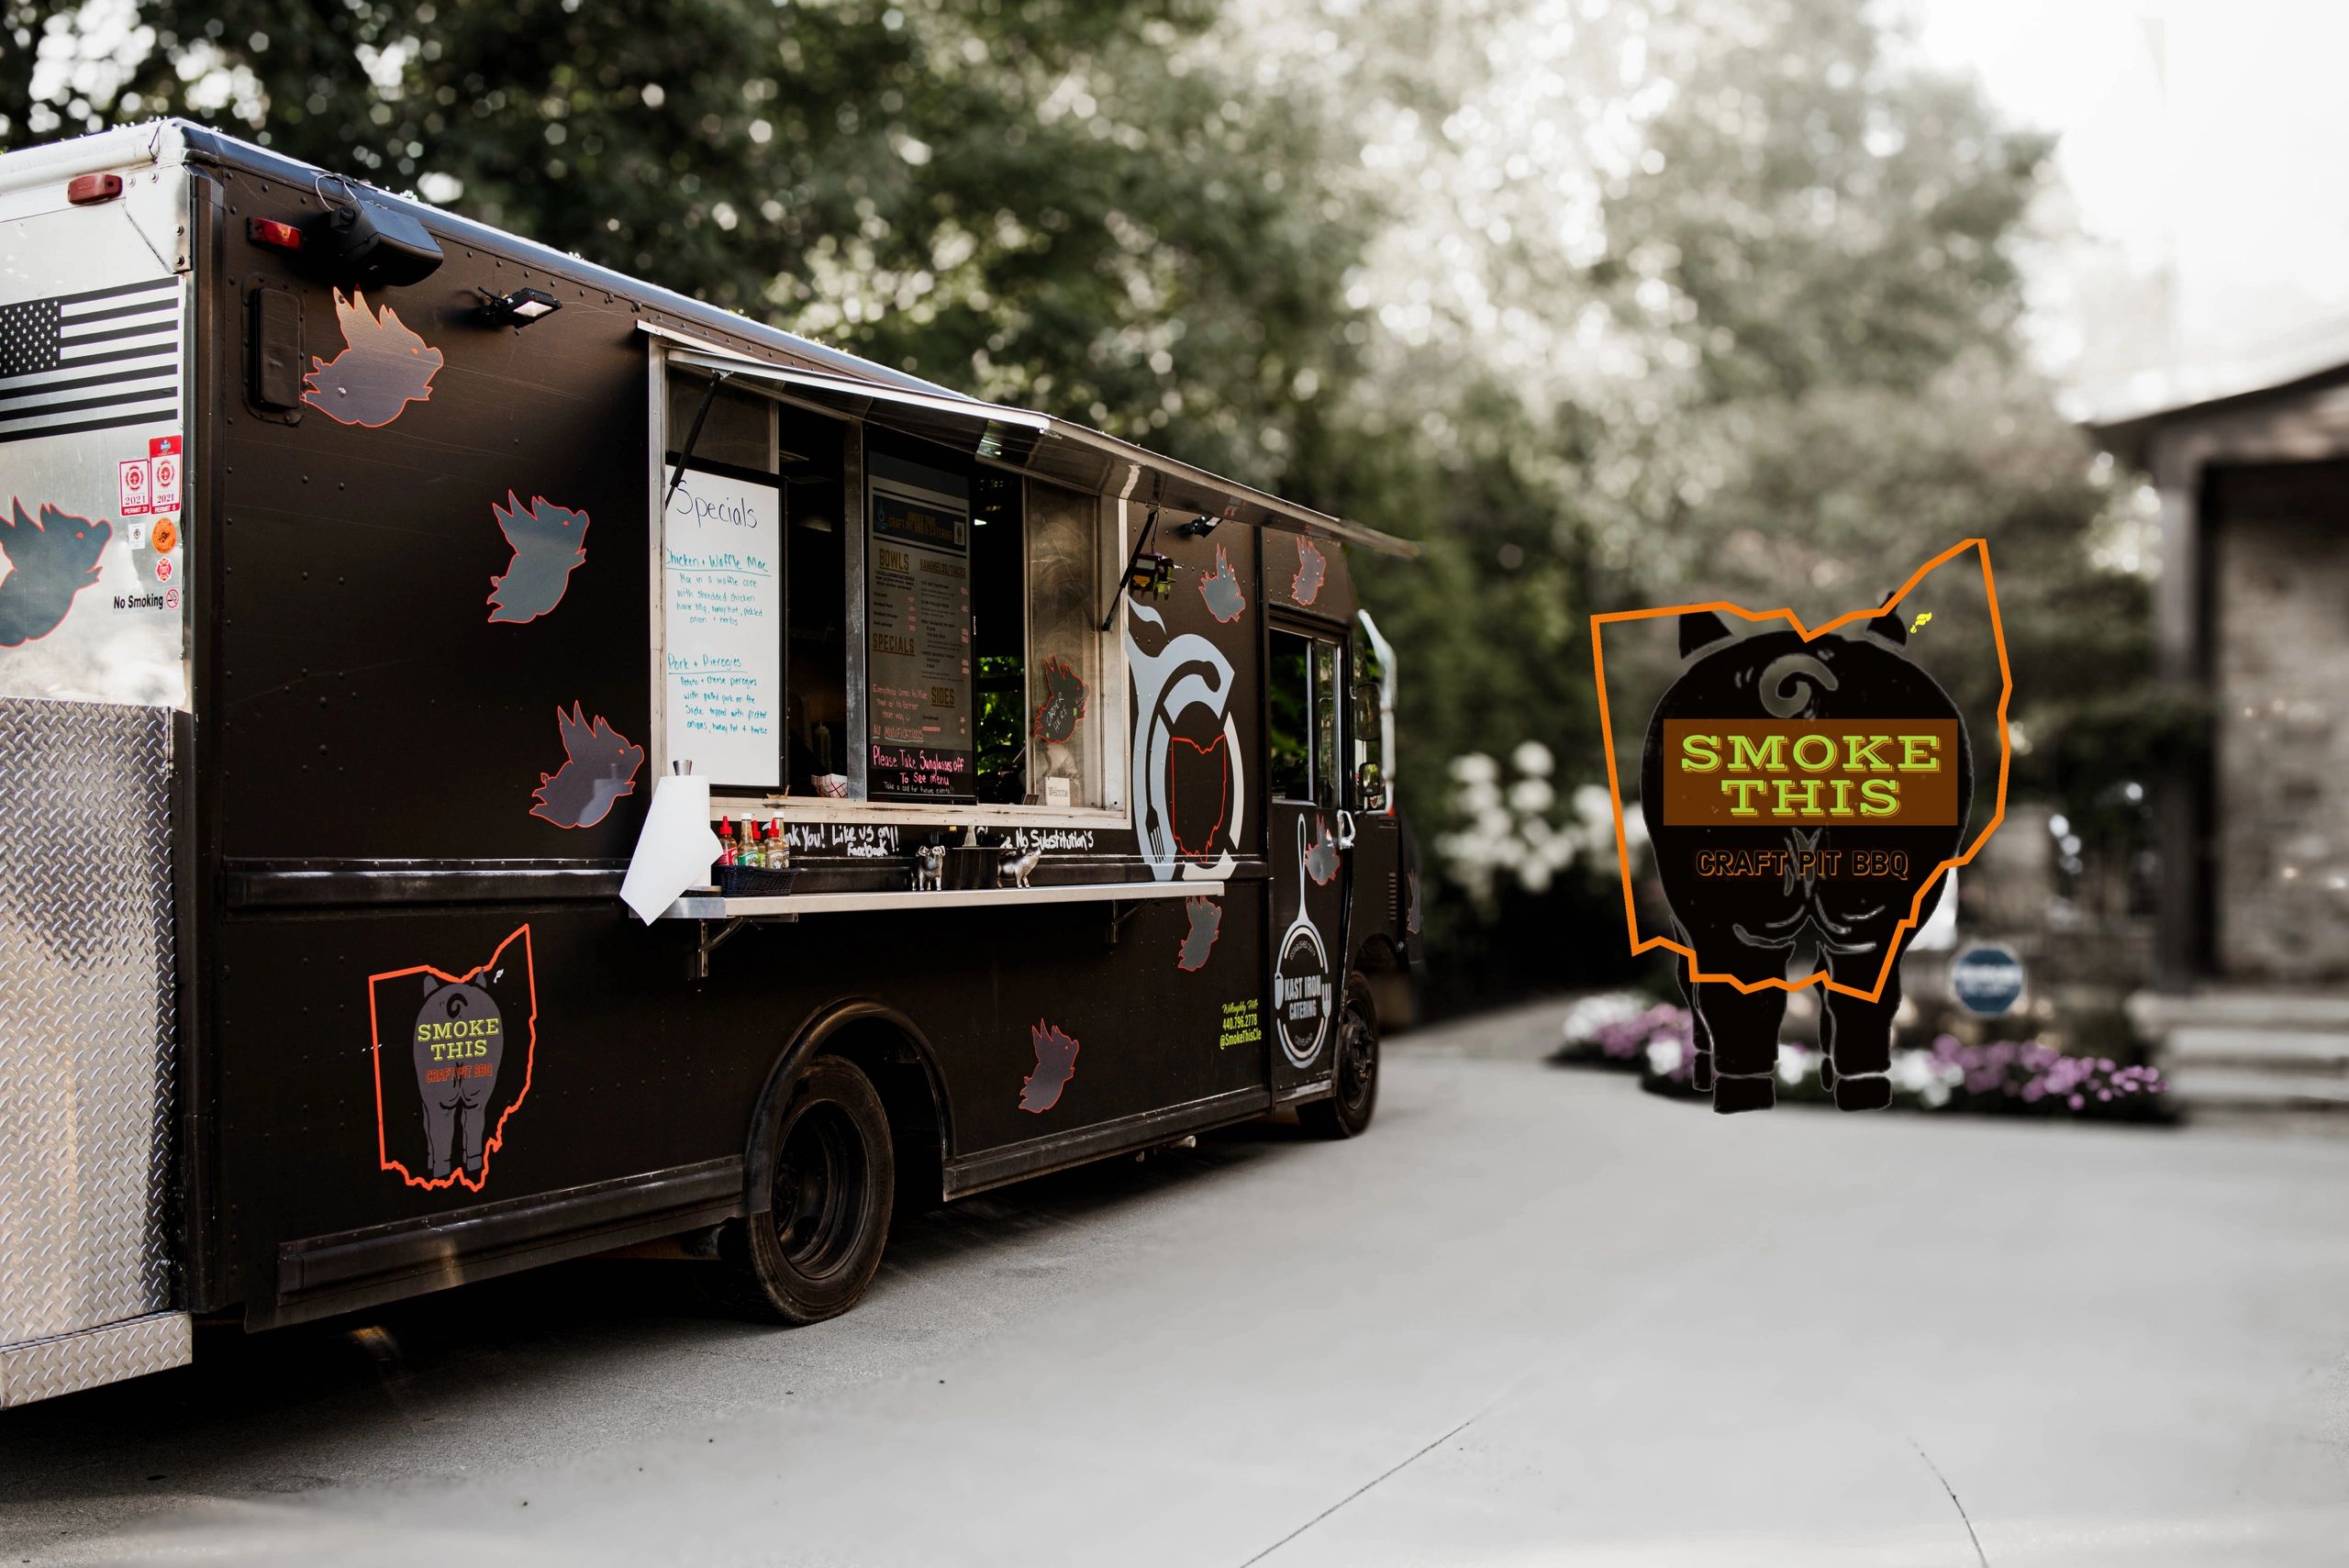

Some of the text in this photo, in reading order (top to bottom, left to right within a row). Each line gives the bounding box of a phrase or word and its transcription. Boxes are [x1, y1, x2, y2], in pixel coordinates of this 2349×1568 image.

[125, 495, 146, 506] 2021
[157, 494, 174, 504] 2021
[676, 479, 758, 528] Specials
[124, 506, 141, 515] PERMIT
[154, 506, 171, 514] PERMIT
[709, 553, 742, 570] Waffle
[747, 556, 769, 572] Mac
[879, 549, 909, 572] BOWLS
[717, 574, 739, 586] waffle
[114, 595, 164, 609] No Smoking
[677, 588, 693, 598] with
[874, 633, 915, 654] SPECIALS
[668, 653, 689, 670] Pork
[703, 654, 741, 672] Pierogies
[931, 686, 954, 705] SIDES
[1046, 691, 1064, 727] ORDER
[1052, 705, 1068, 732] HERE
[873, 745, 964, 776] Please Take Sunglasses off
[899, 772, 908, 784] To
[802, 824, 825, 851] You!
[832, 825, 856, 846] Like
[1016, 827, 1029, 849] No
[1030, 828, 1094, 851] Substitution's
[1285, 974, 1321, 1001] KAST IRON
[1289, 1000, 1317, 1020] CATERING
[417, 1018, 500, 1043] SMOKE
[1219, 1028, 1262, 1050] @SmokeThisCle
[430, 1040, 488, 1062] THIS
[425, 1062, 494, 1084] CRAFT PIT BBQ
